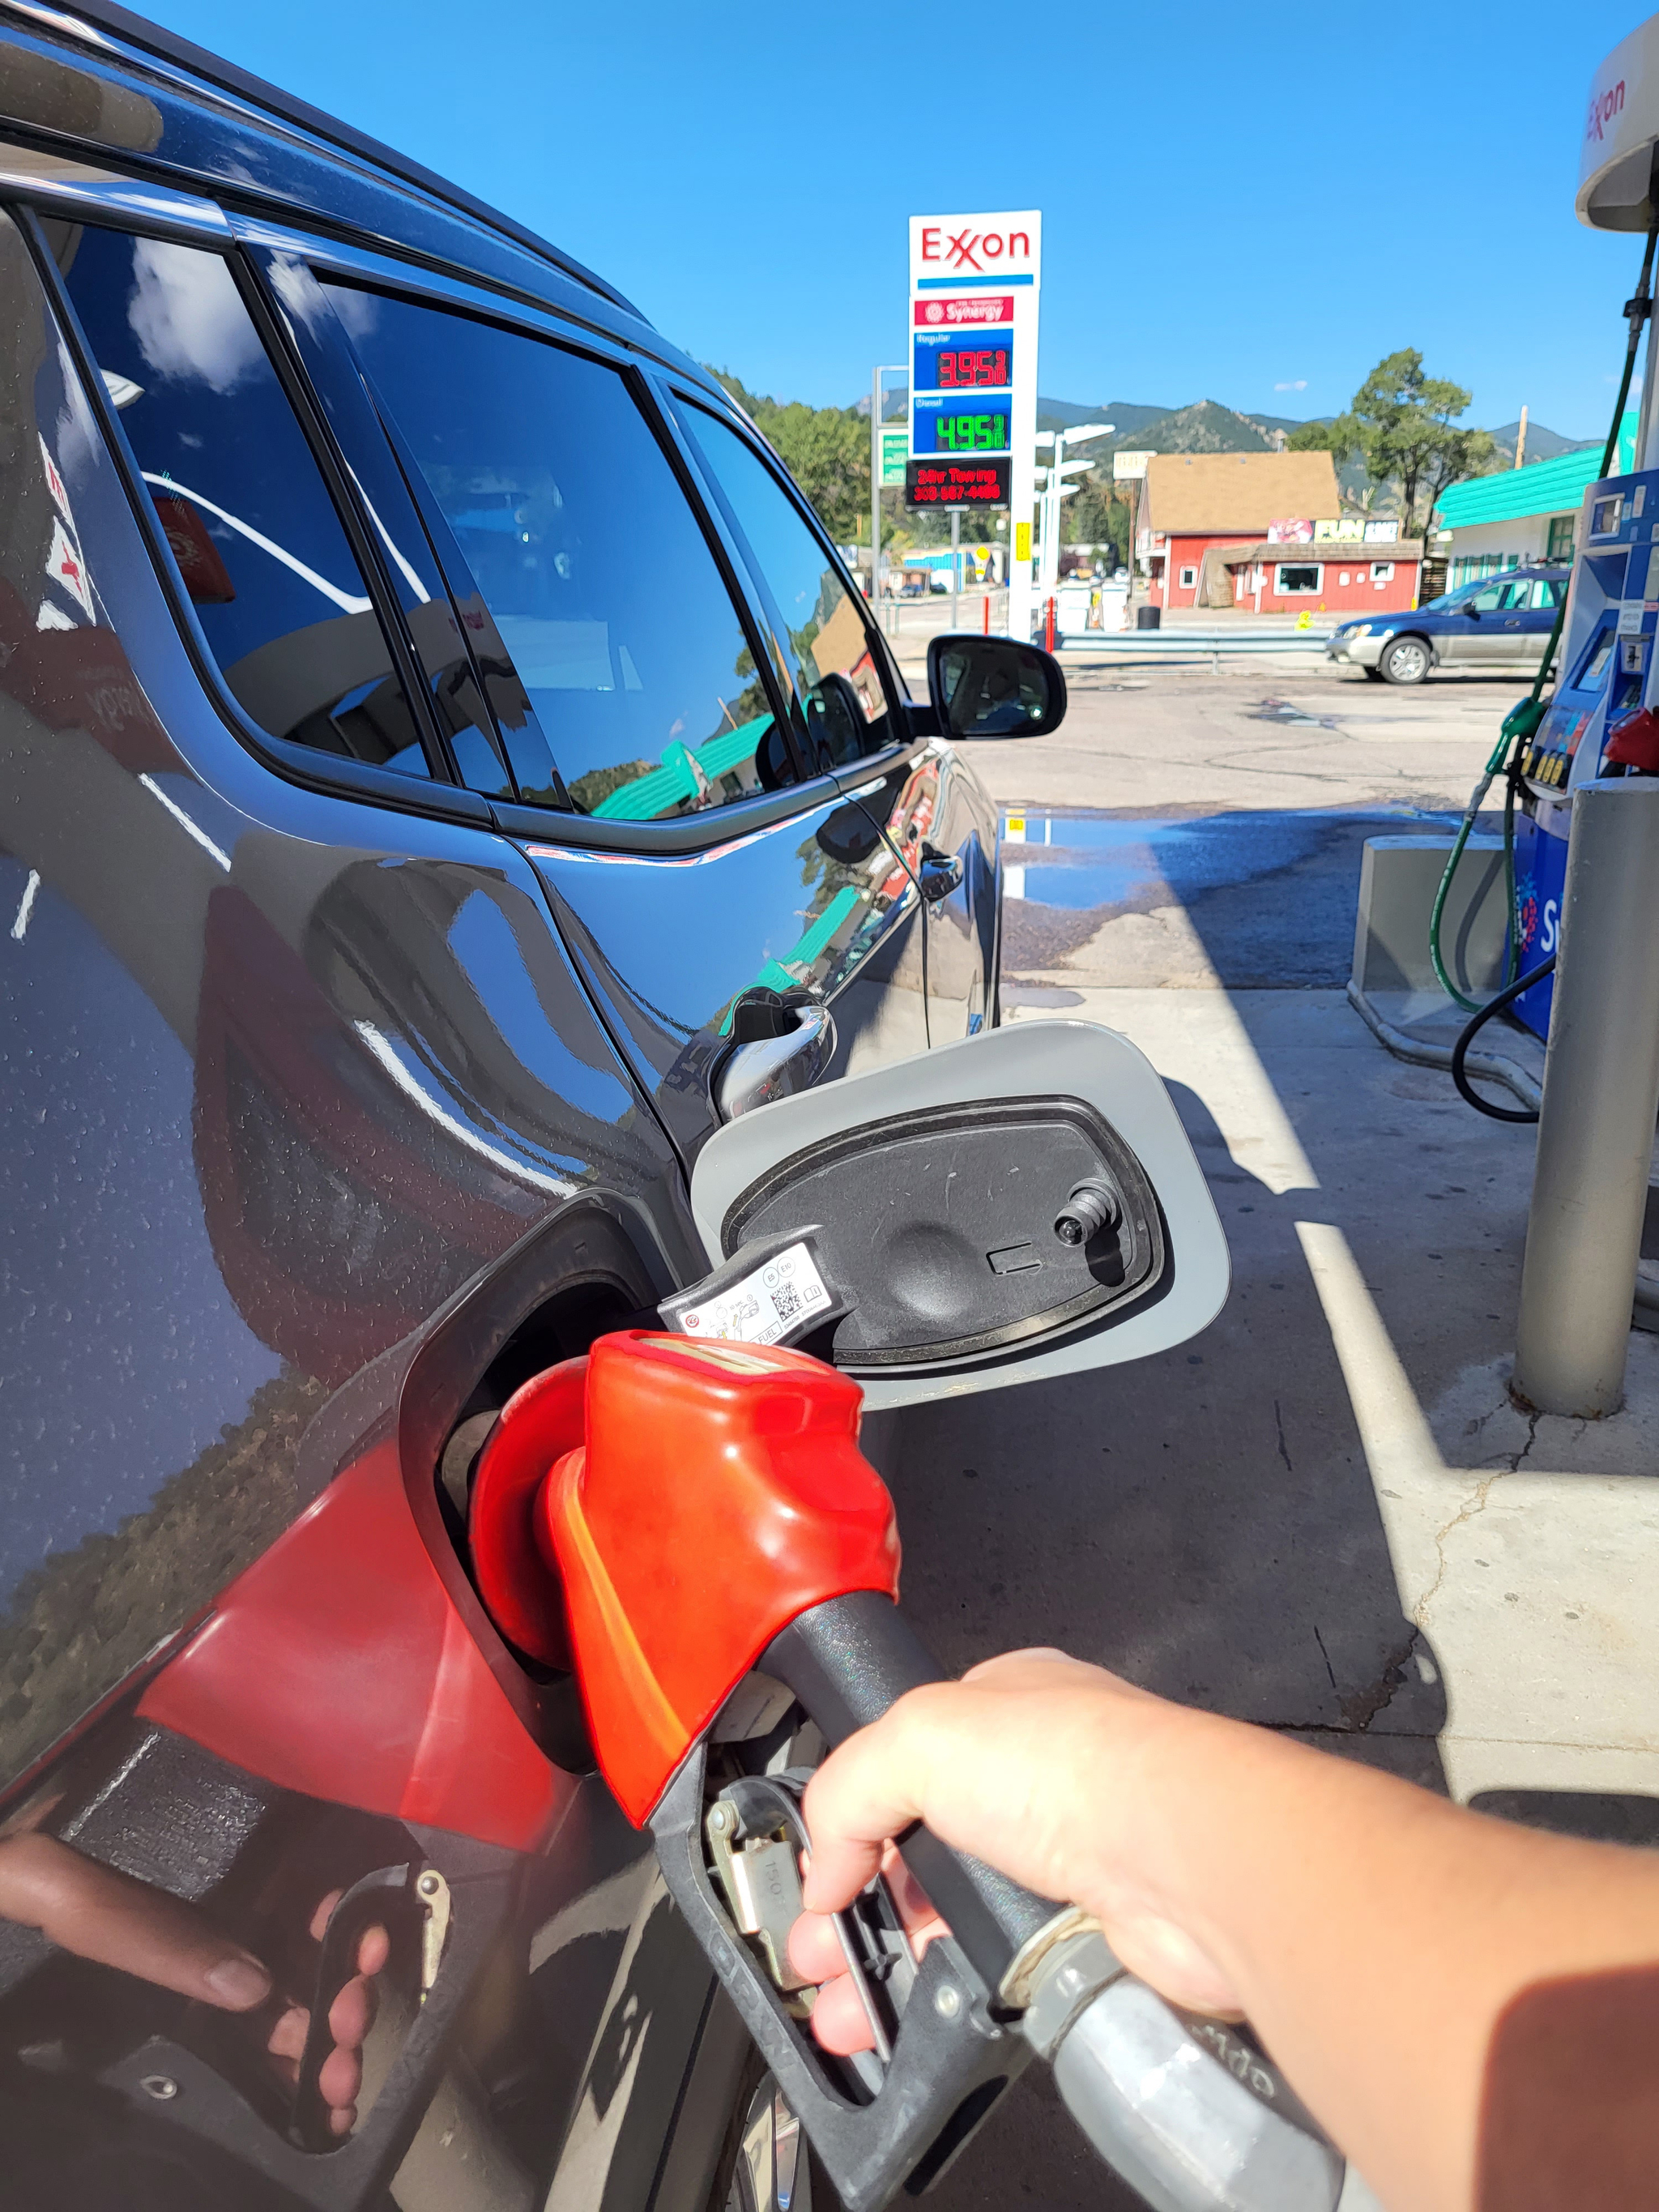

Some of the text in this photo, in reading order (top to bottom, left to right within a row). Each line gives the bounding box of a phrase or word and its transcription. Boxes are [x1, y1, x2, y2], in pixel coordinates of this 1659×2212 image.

[922, 228, 1030, 272] Exxon
[946, 302, 1004, 322] Synergy
[948, 468, 997, 485] Towing
[1316, 519, 1365, 540] FUN
[758, 1328, 777, 1343] FUEL
